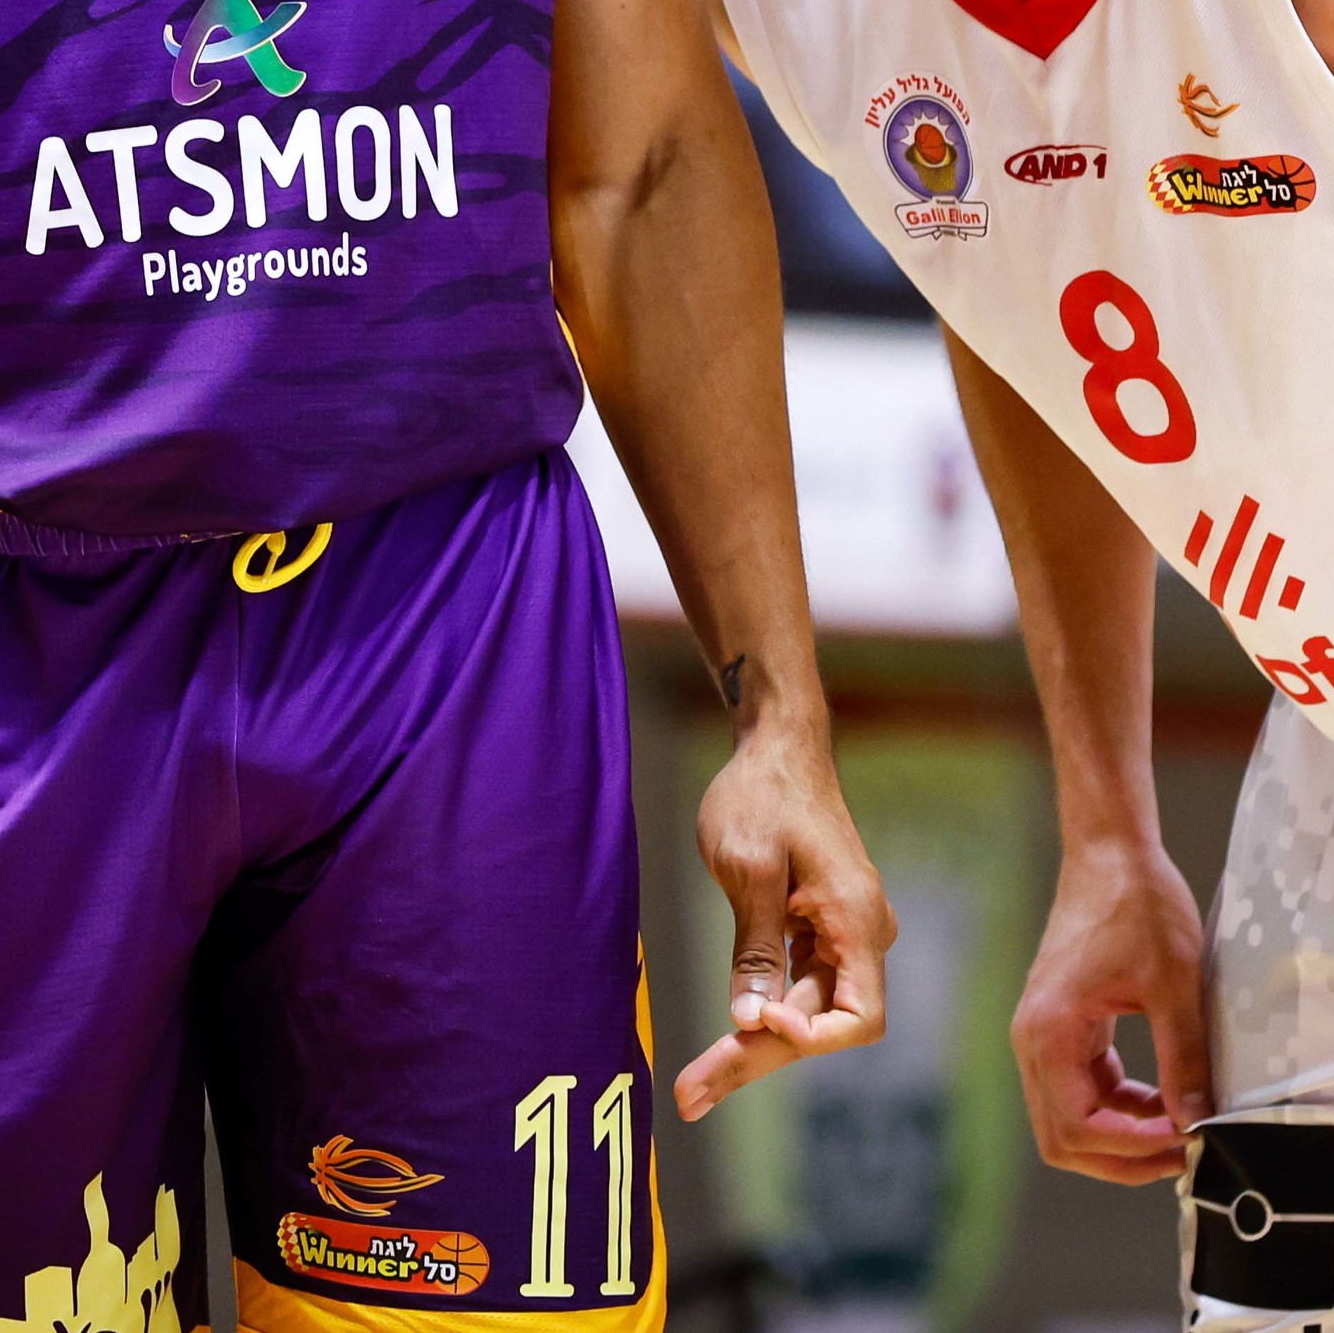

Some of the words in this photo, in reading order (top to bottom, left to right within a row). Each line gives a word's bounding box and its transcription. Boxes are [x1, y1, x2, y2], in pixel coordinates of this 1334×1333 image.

[896, 74, 930, 94] גליל
[24, 103, 460, 256] ATSMON
[1014, 152, 1087, 180] AND
[1092, 152, 1107, 179] 1
[1221, 165, 1257, 188] ליגת
[1171, 172, 1263, 206] Winner
[1264, 178, 1291, 202] סל
[906, 207, 947, 225] Galil
[142, 231, 368, 302] Playgrounds
[1059, 269, 1197, 465] 8
[514, 1073, 636, 1297] 11
[300, 1231, 418, 1278] Winner
[370, 1236, 416, 1258] ליגת
[423, 1255, 456, 1282] סל
